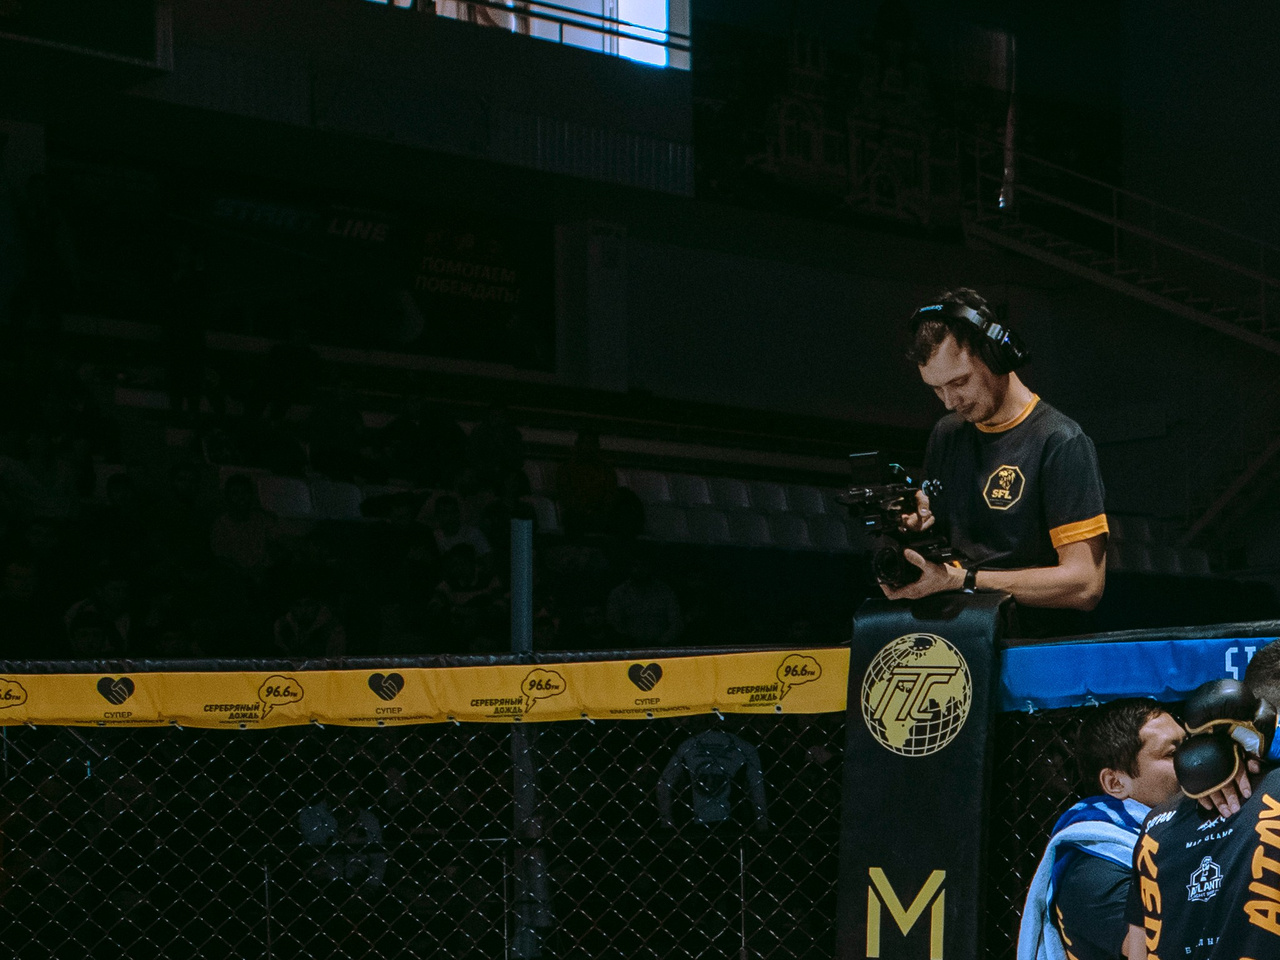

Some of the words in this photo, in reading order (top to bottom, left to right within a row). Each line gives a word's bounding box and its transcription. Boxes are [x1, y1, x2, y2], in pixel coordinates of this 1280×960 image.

[726, 682, 779, 695] СЕРЕБРЯНЫЙ
[470, 695, 524, 707] СЕРЕБРЯНЫЙ
[634, 697, 661, 706] СУПЕР
[749, 693, 779, 703] ДОЖДЬ
[203, 702, 260, 713] СЕРЕБРЯНЫЙ
[493, 706, 523, 714] ДОЖДЬ
[228, 712, 259, 720] ДОЖДЬ
